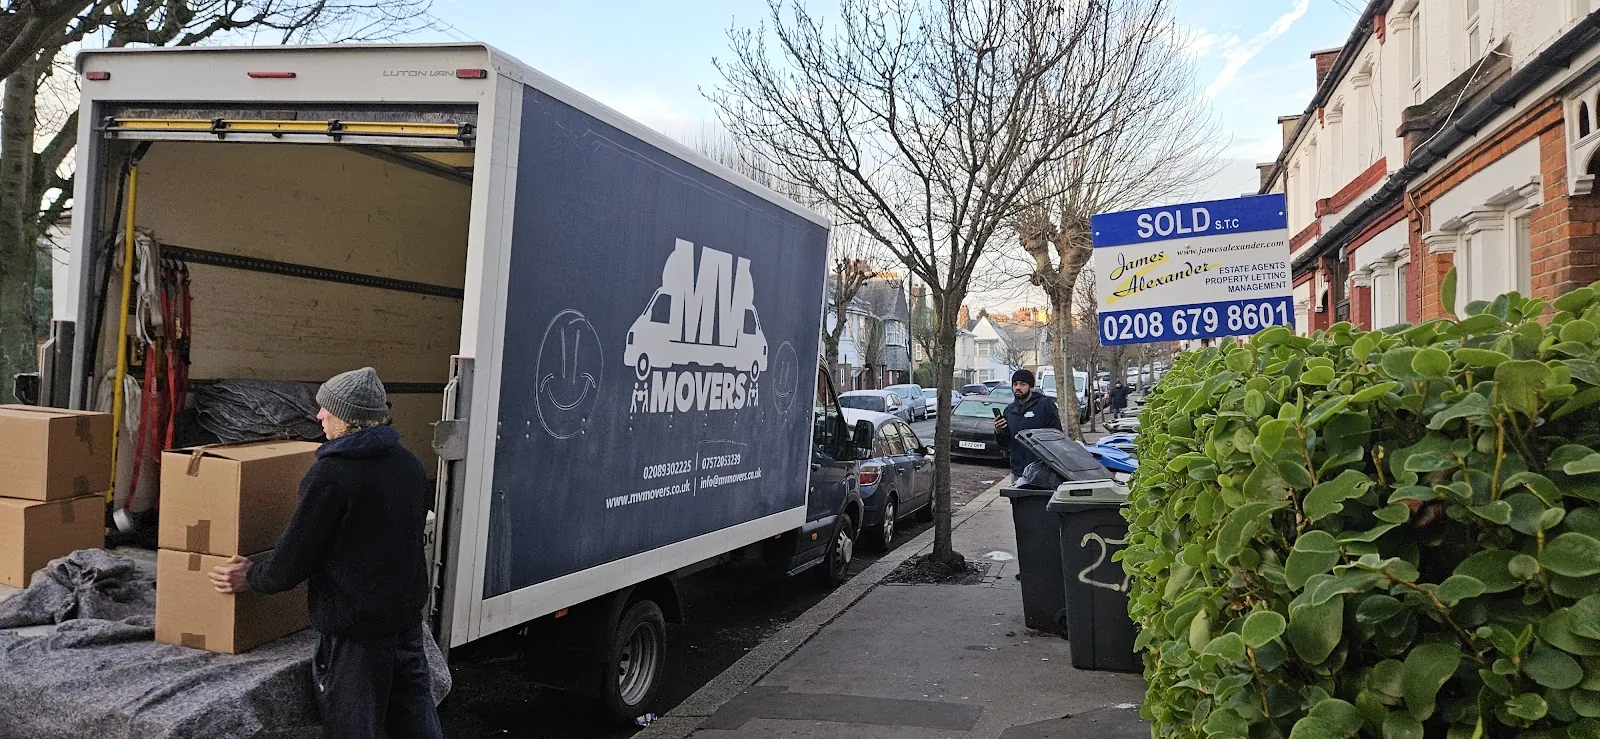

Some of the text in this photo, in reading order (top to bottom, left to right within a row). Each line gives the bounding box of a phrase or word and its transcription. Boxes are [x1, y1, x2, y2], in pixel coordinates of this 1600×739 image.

[1137, 207, 1240, 239] SOLD S.T.C
[1177, 240, 1284, 256] www.jamesalexander.com
[1109, 250, 1165, 281] James
[1112, 261, 1210, 298] Alexander
[1205, 271, 1287, 285] PROPERTY LETTING
[1219, 261, 1286, 275] ESTATE AGENTS
[669, 237, 751, 347] MV
[1228, 280, 1287, 293] MANAGEMENT
[1103, 300, 1288, 341] 0208 679 8601
[650, 371, 748, 413] MOVERS
[643, 453, 741, 480] 02089302225 07572053239
[605, 467, 762, 509] www.mvmovers.co.uk info@mvmovers.co.uk
